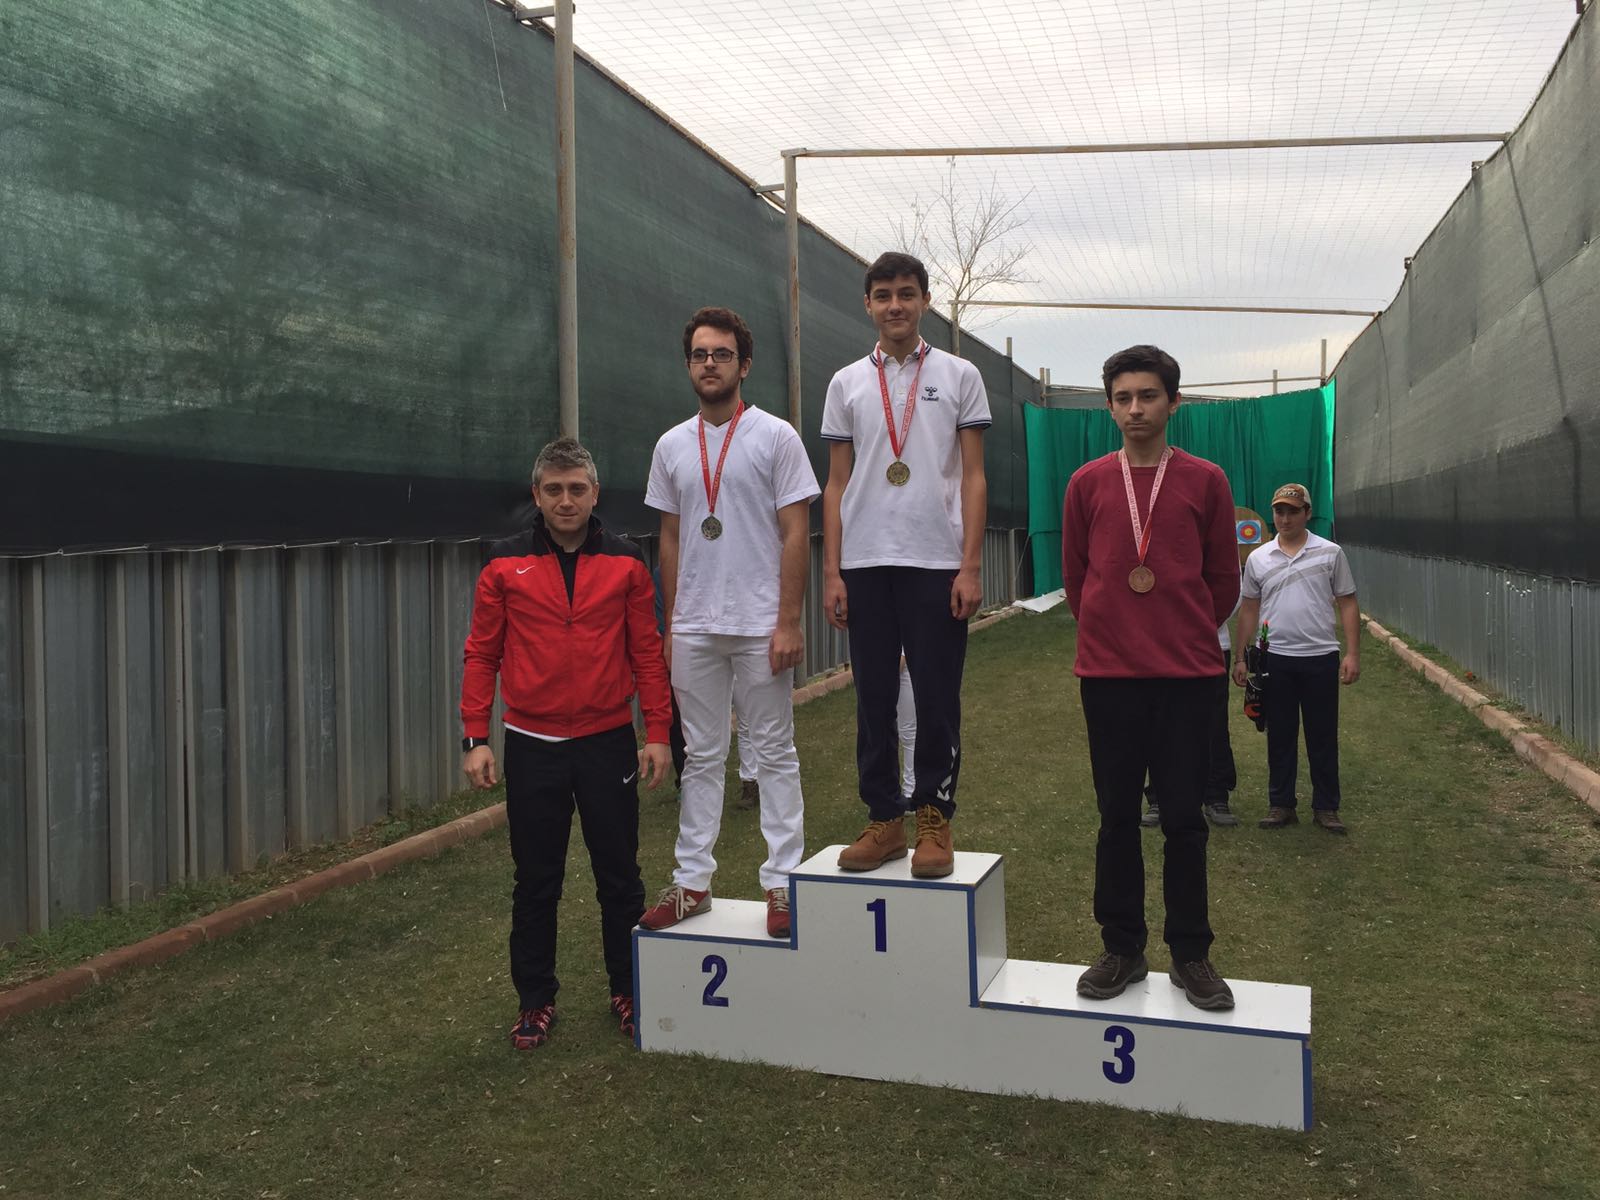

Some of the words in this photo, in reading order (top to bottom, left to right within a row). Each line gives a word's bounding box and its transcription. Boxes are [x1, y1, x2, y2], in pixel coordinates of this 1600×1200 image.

[866, 898, 889, 953] 1
[702, 954, 730, 1008] 2
[1102, 1025, 1136, 1084] 3
